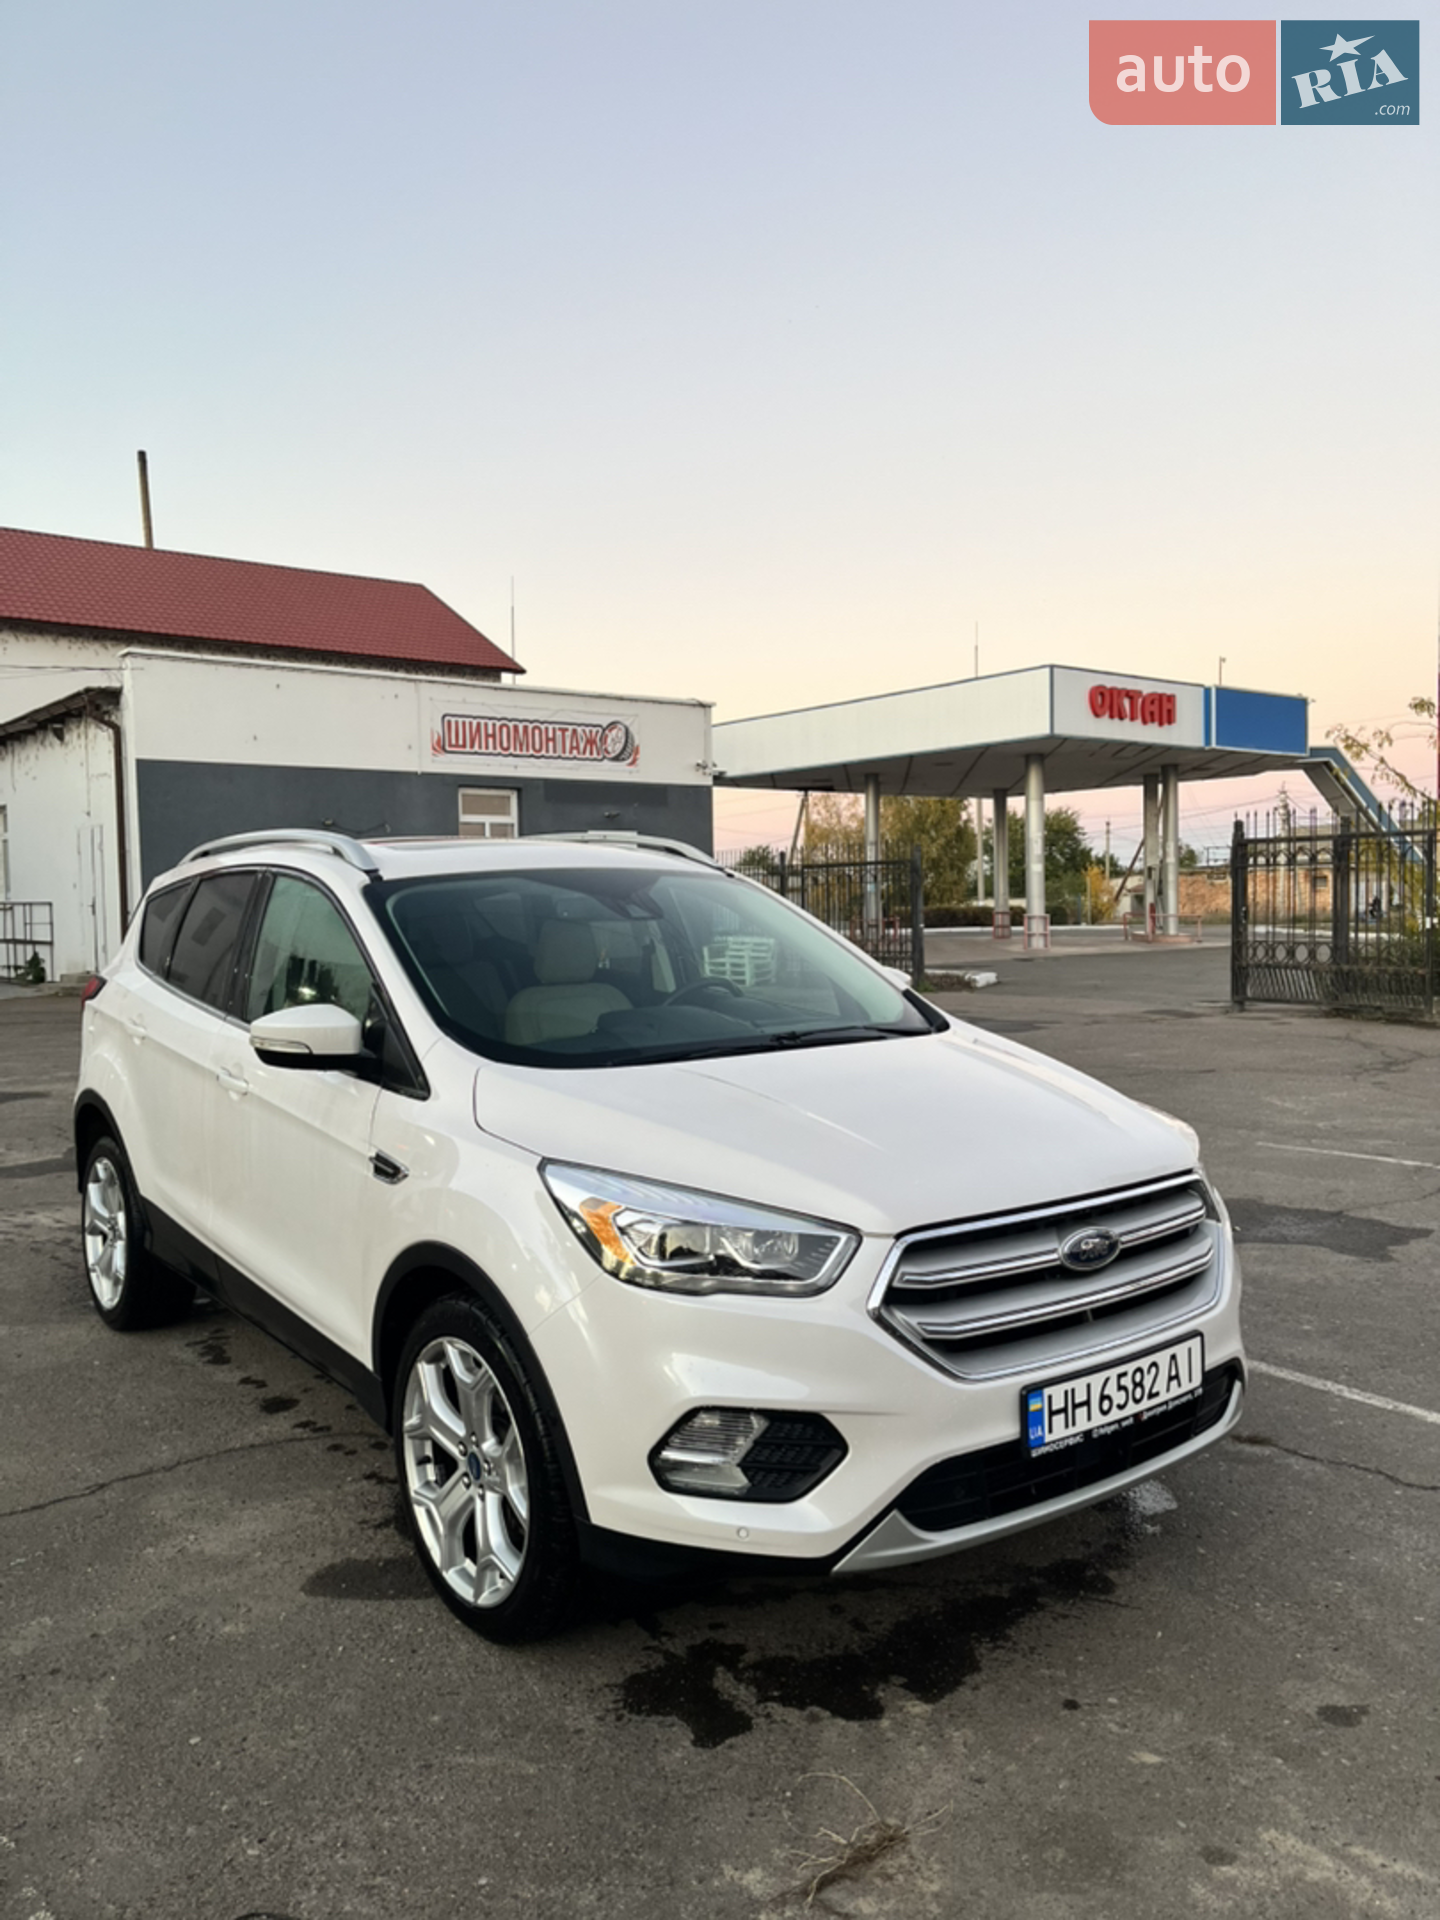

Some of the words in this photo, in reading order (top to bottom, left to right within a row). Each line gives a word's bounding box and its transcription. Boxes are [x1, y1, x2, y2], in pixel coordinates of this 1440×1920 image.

[1088, 684, 1176, 727] ОКТАН
[446, 718, 601, 757] ШИНОМОНТАЖ
[1098, 1361, 1160, 1416] 6582
